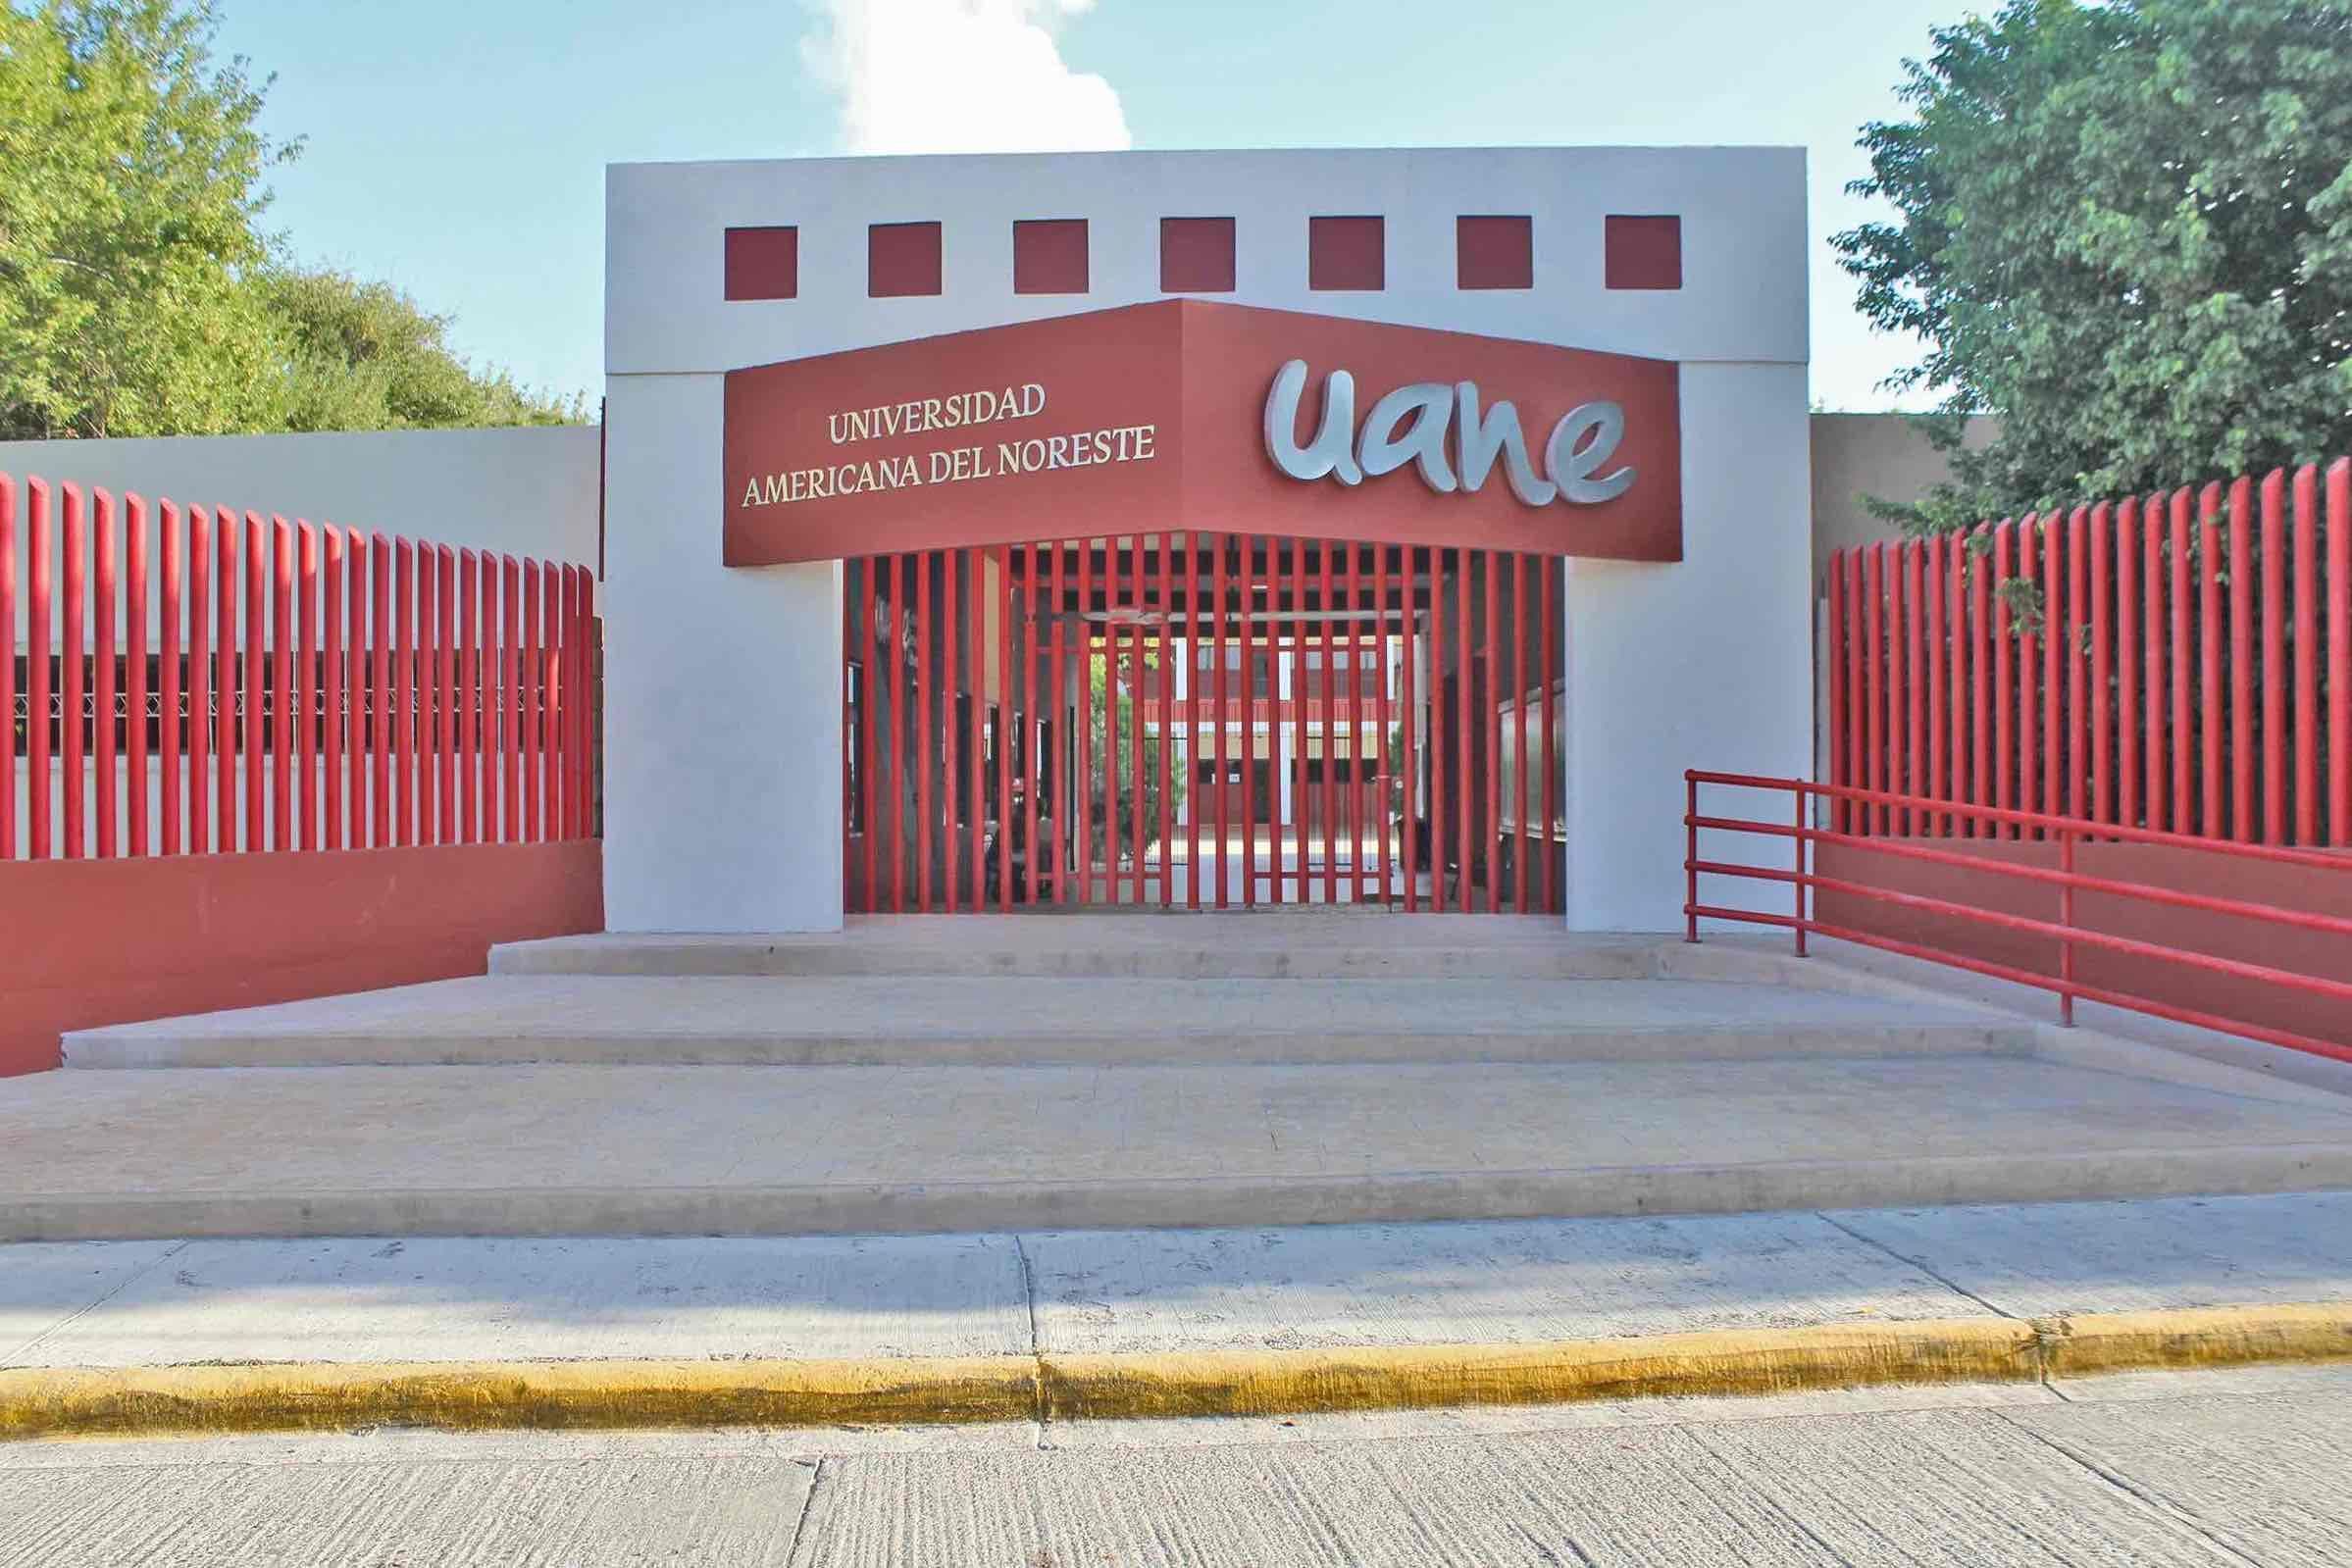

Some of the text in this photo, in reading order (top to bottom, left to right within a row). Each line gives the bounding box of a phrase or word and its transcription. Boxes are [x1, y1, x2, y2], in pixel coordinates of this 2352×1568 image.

[829, 383, 1046, 444] UNIVERSIDAD
[1263, 359, 1637, 507] uane
[741, 424, 1156, 508] AMERICANA DEL NORESTE
